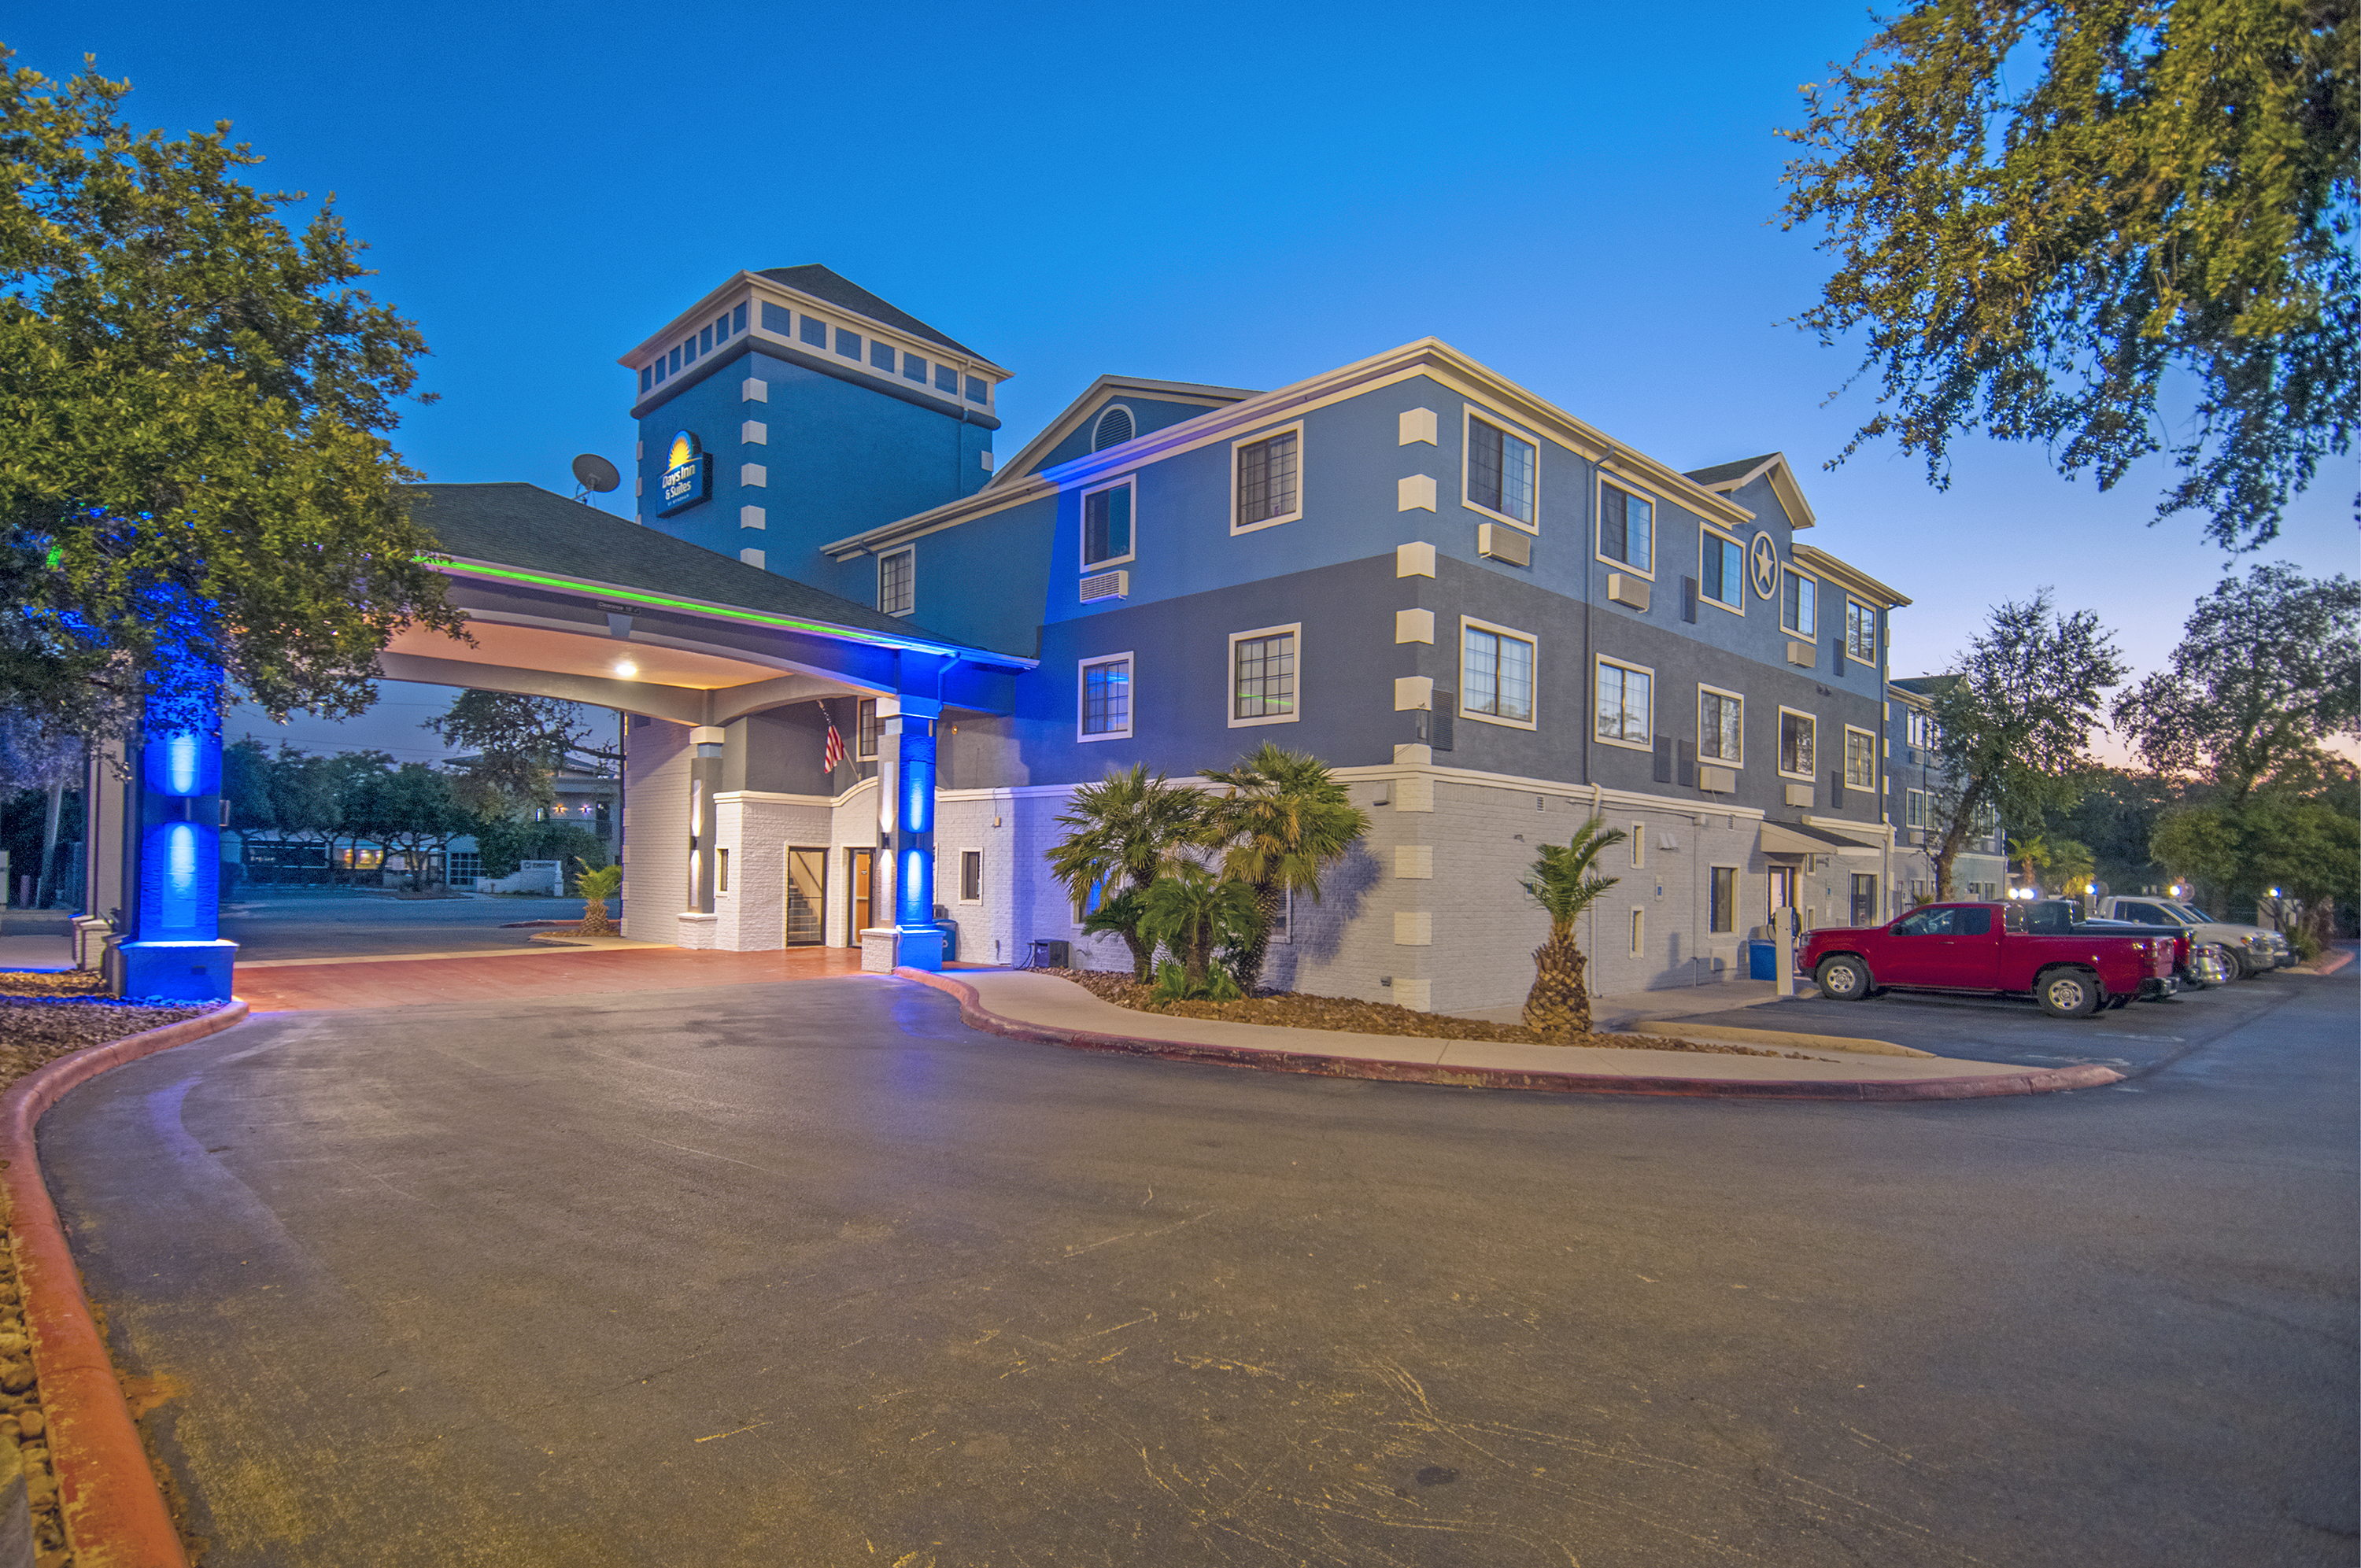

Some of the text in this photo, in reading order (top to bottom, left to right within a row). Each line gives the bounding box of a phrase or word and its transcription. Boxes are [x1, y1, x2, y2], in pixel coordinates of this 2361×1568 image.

[662, 464, 696, 489] Days Inn
[665, 489, 671, 500] &
[671, 481, 692, 498] Suites
